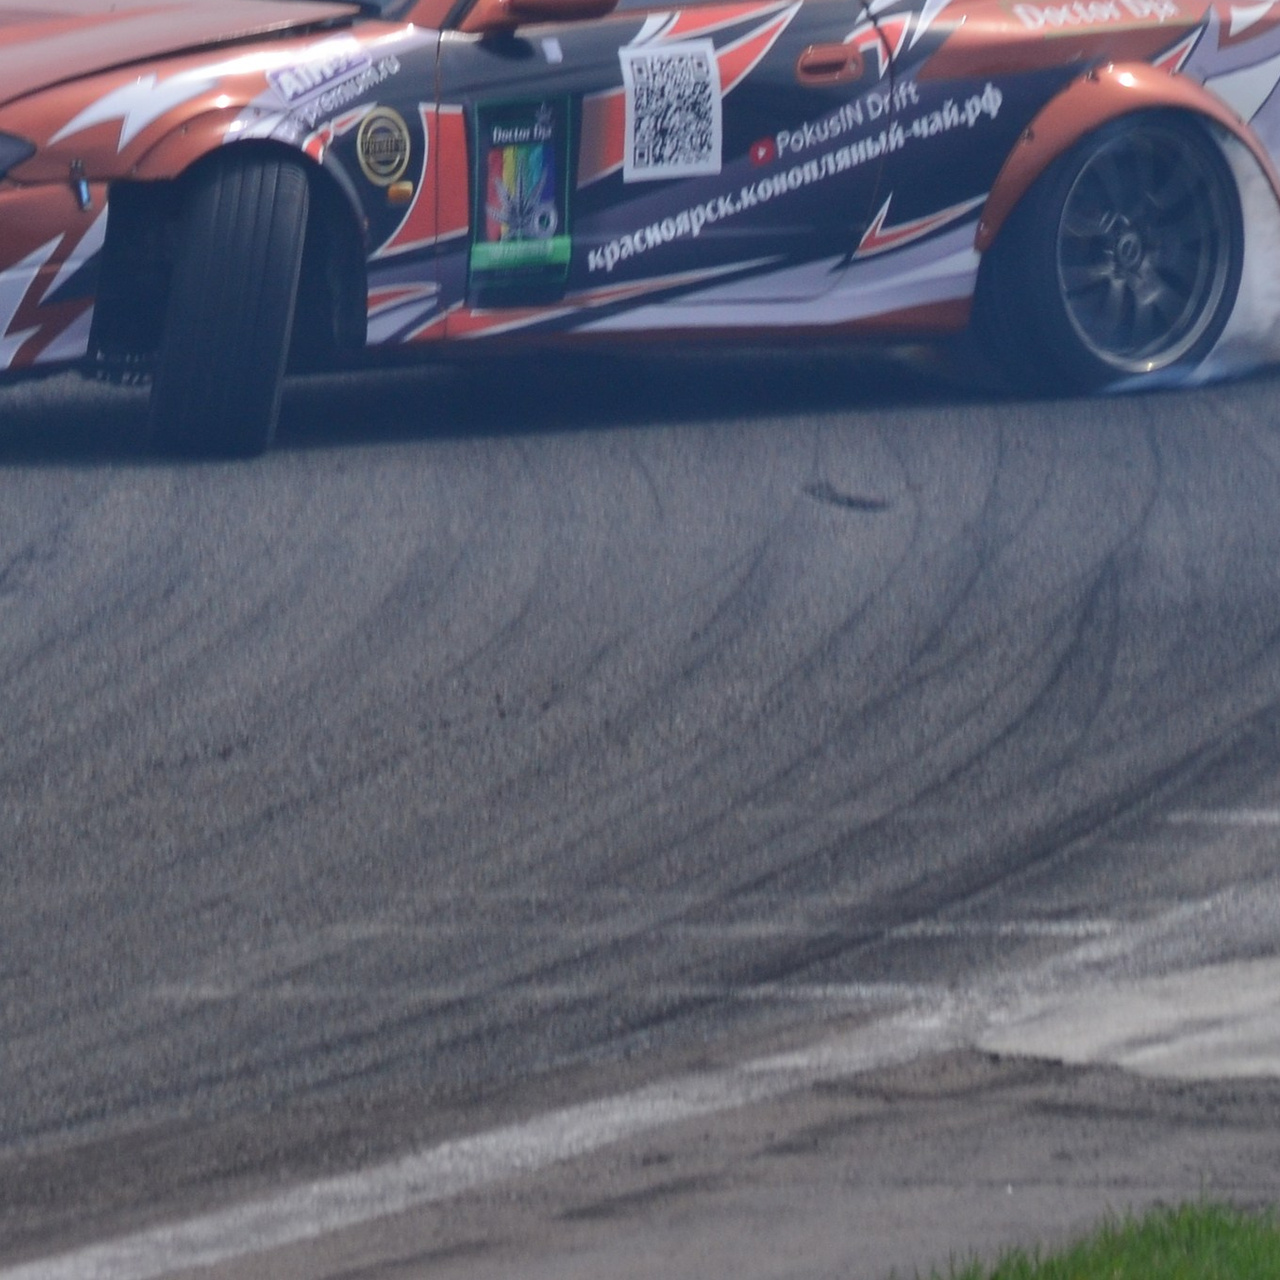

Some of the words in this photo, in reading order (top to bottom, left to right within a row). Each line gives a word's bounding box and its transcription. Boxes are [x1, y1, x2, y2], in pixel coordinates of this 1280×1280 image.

[1013, 0, 1122, 30] Doctor
[866, 80, 920, 121] Drift
[492, 124, 531, 145] Doctor
[587, 81, 1003, 274] красноярск.конопляный-чай.рф
